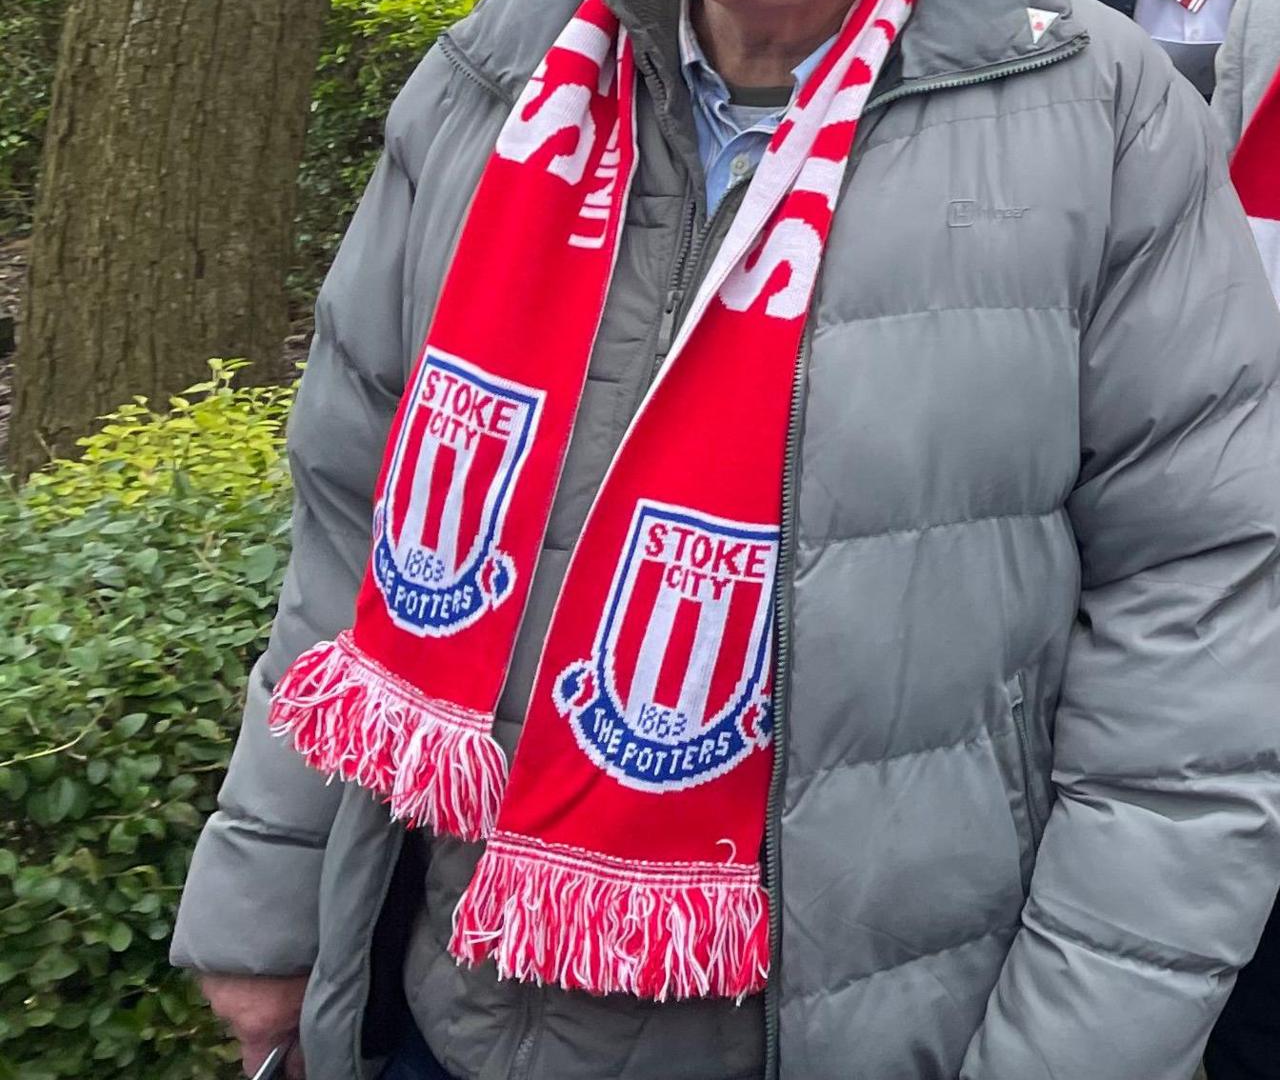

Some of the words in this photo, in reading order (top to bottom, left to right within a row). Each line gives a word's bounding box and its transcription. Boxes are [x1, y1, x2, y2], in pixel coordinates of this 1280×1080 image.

[422, 370, 519, 435] STOKE
[429, 410, 481, 451] CITY
[404, 548, 446, 583] 1863
[645, 522, 771, 578] STOKE
[379, 548, 395, 595] THE
[393, 583, 474, 620] POTTERS
[665, 565, 733, 601] CITY
[593, 707, 624, 754] THE
[620, 731, 732, 777] POTTERS
[637, 703, 688, 739] 1863
